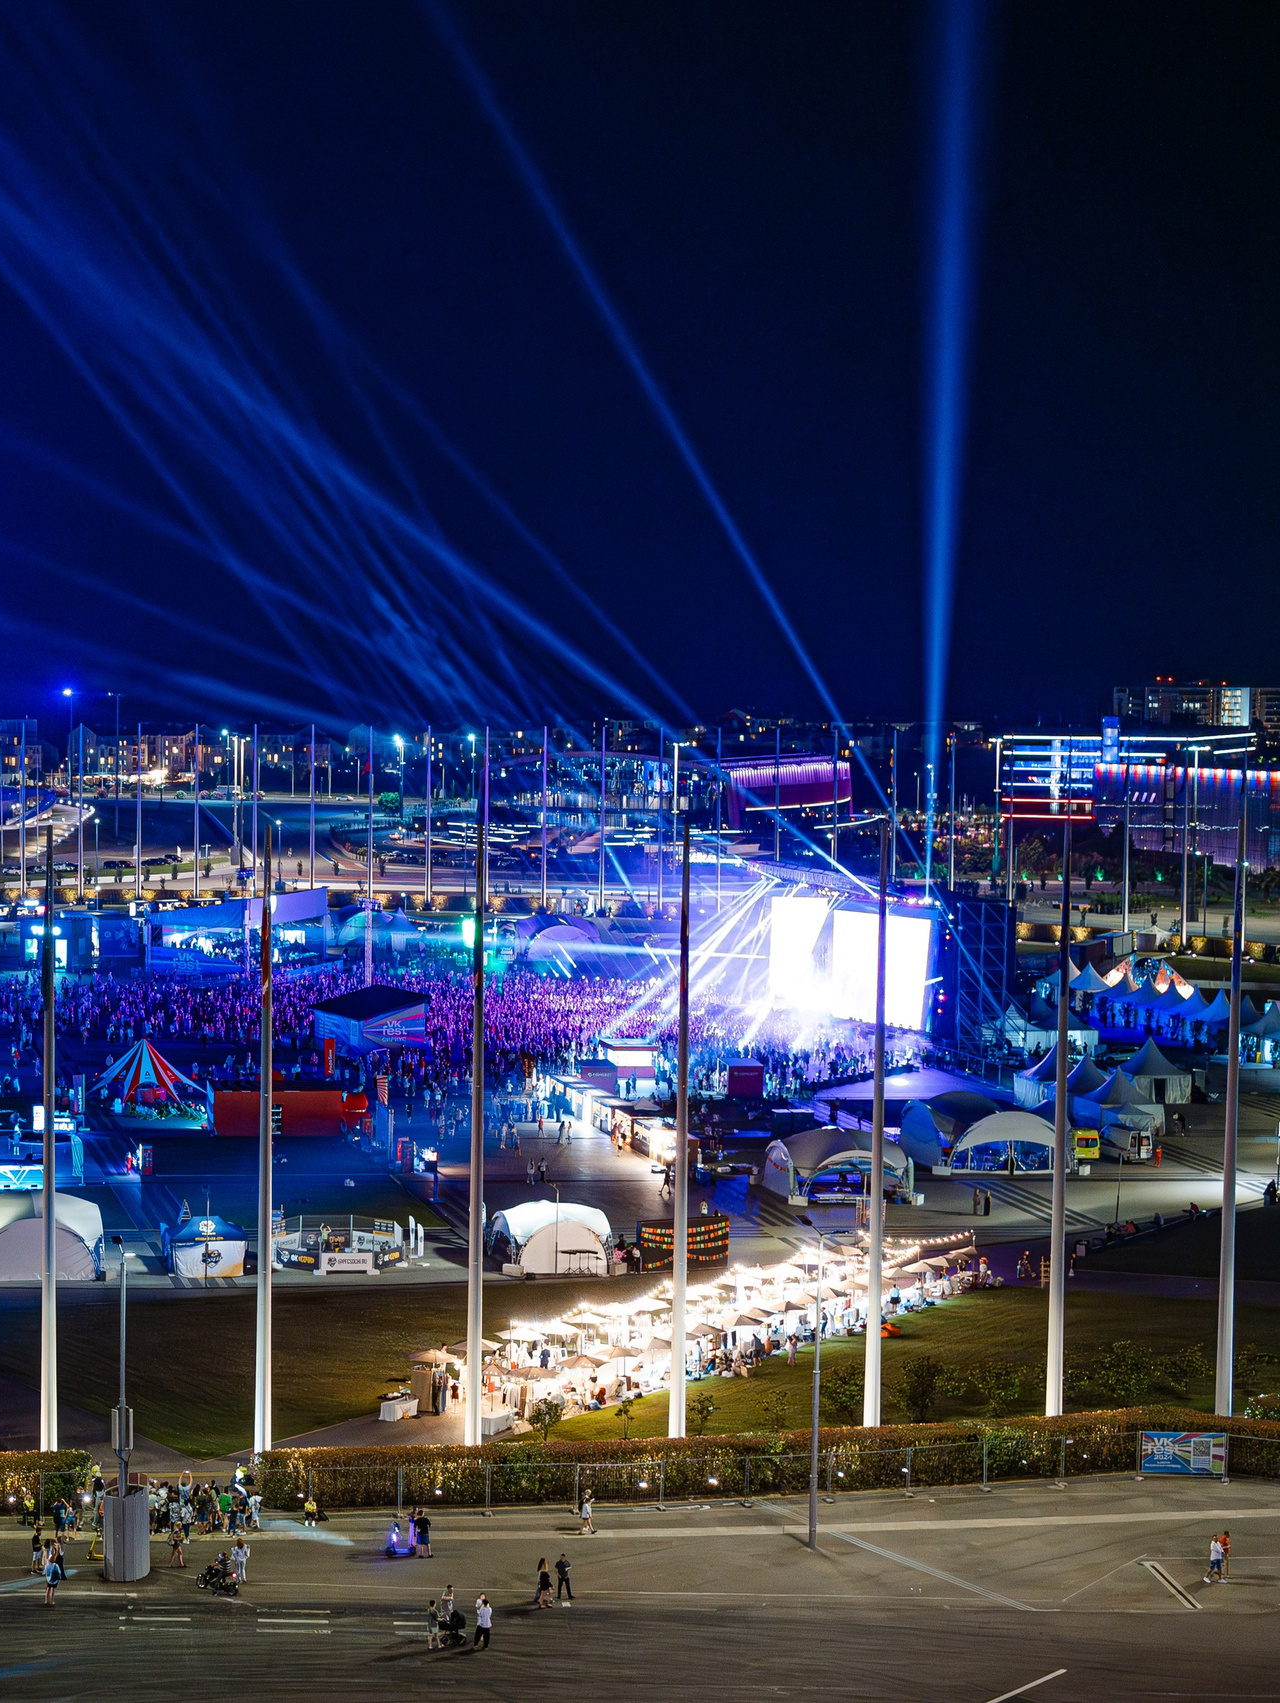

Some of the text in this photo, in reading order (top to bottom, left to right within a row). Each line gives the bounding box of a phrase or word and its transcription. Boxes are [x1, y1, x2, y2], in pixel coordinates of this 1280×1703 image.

[177, 952, 195, 961] VK
[173, 958, 200, 970] fest
[386, 1020, 402, 1028] VK
[382, 1025, 407, 1036] fest
[1153, 1437, 1174, 1446] VK
